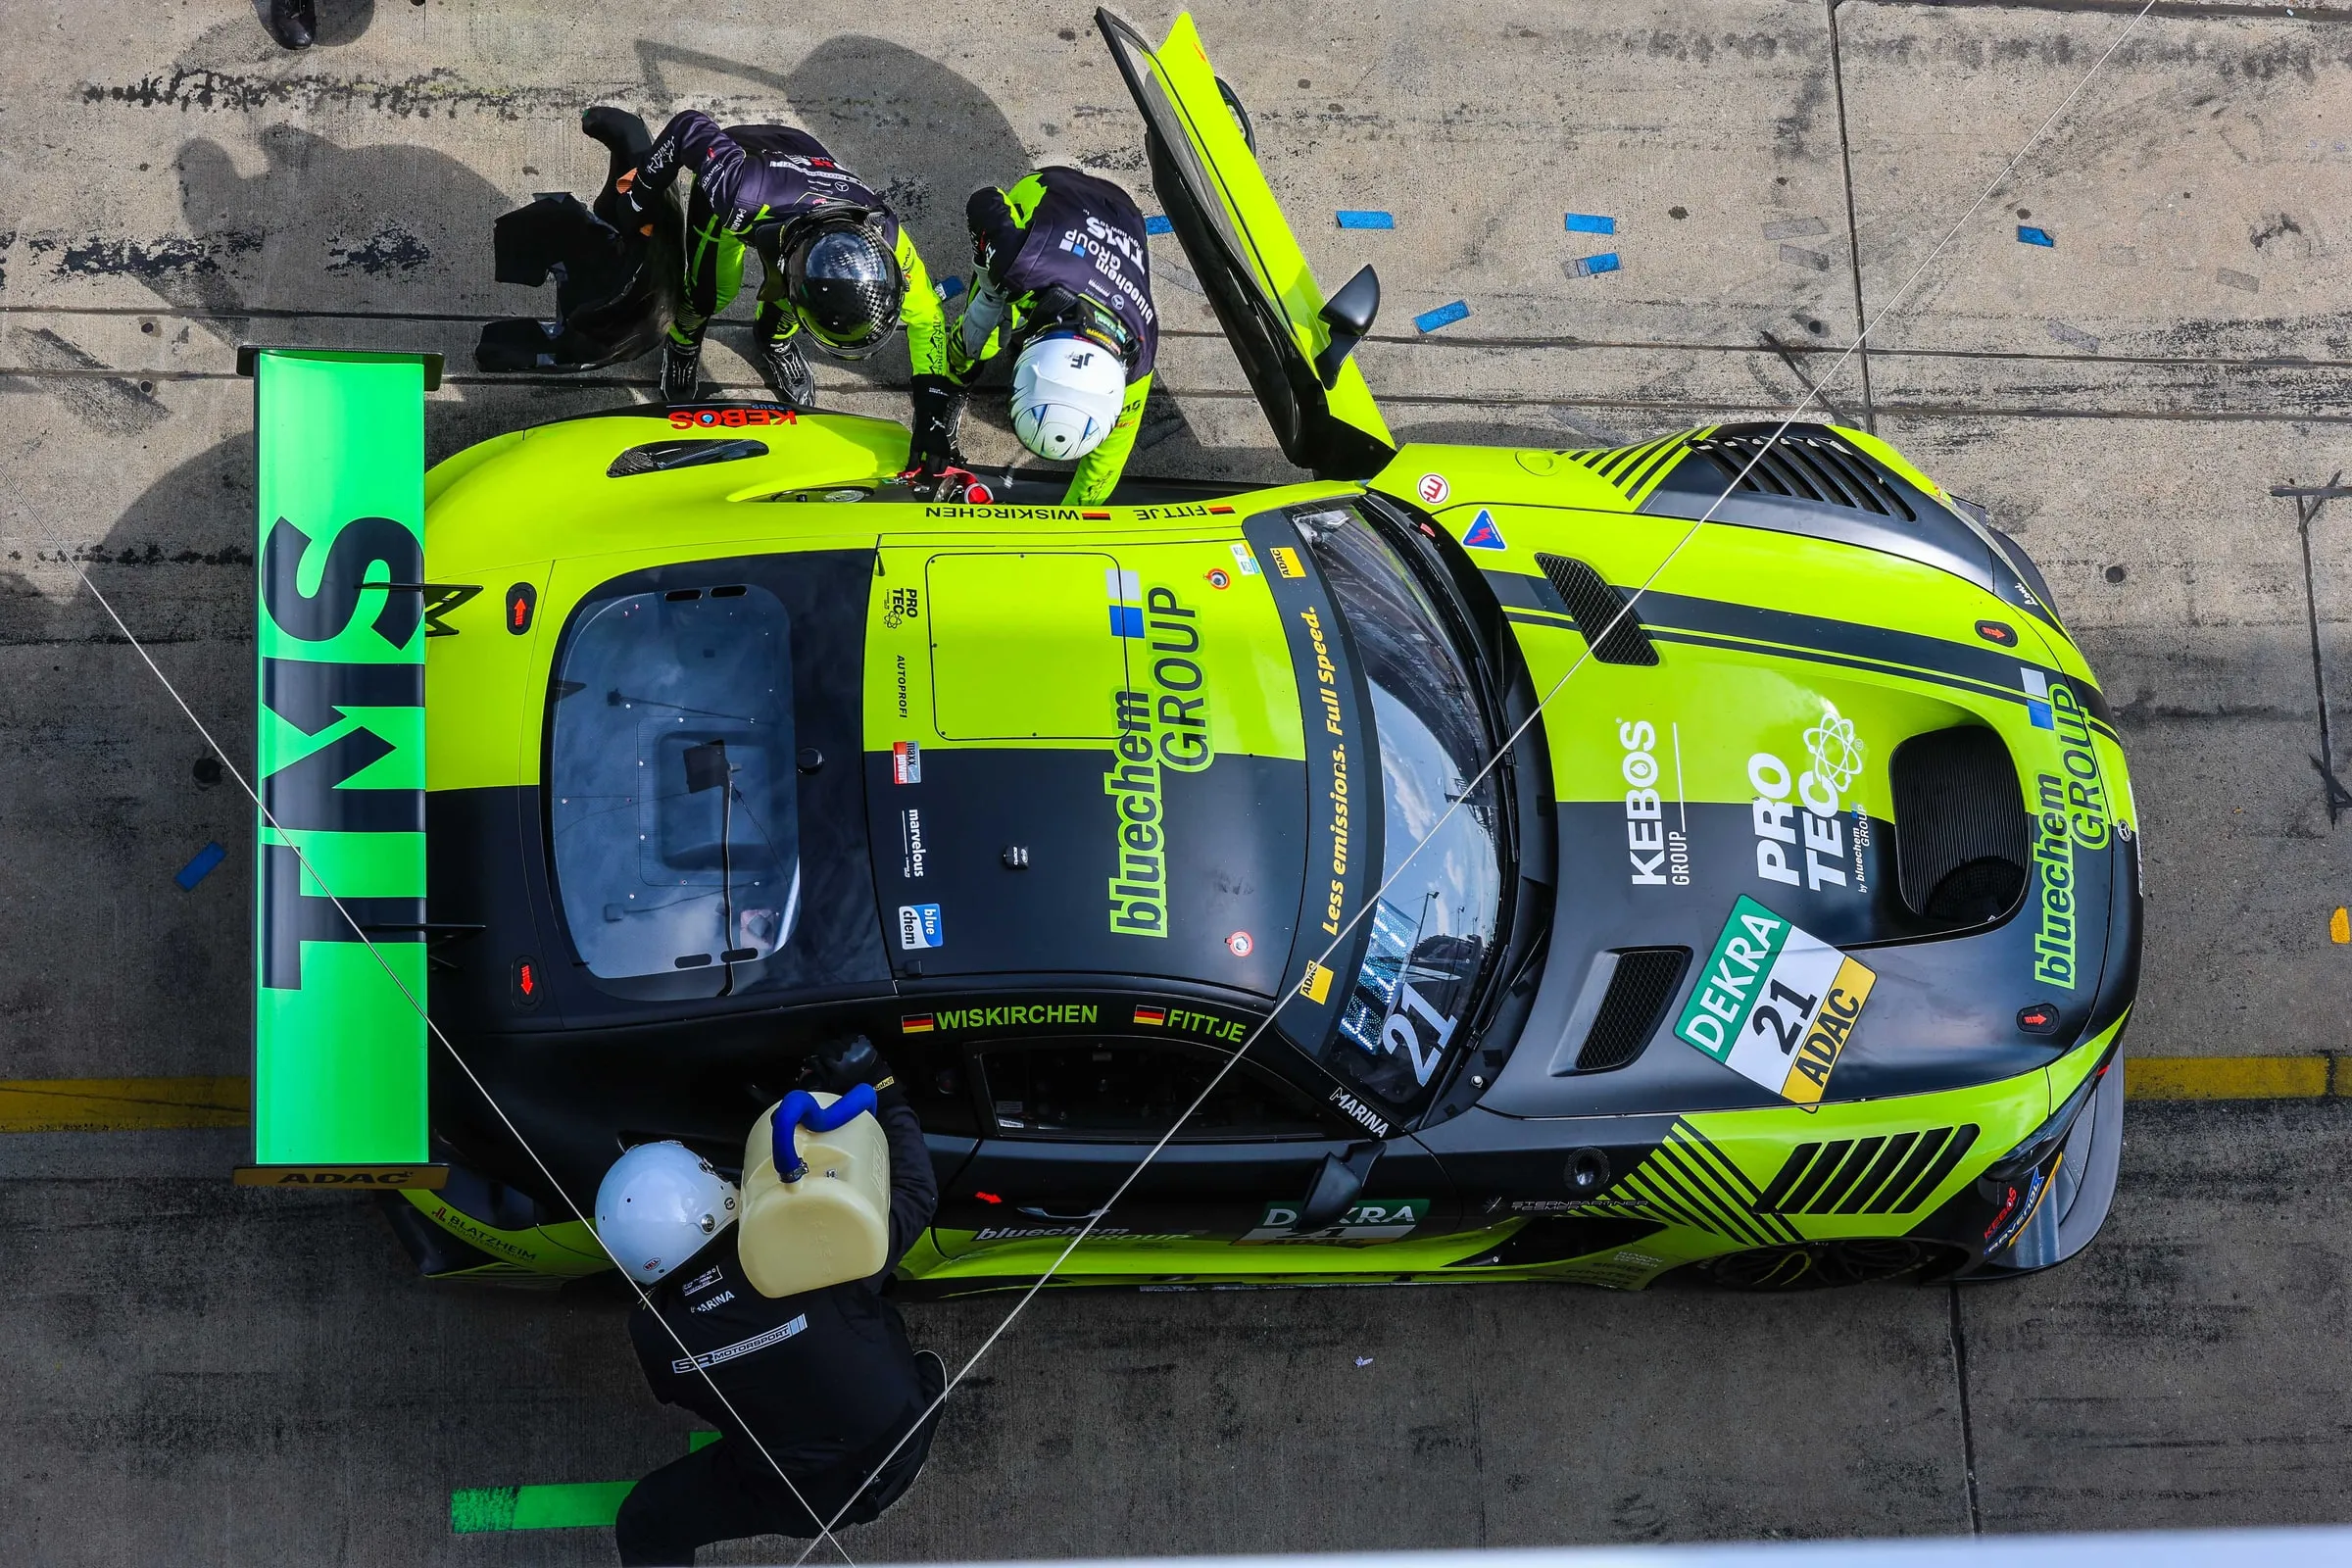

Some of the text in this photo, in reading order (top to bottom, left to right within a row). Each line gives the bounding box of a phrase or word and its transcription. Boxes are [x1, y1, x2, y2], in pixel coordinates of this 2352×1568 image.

[1064, 228, 1121, 270] GROUP
[1086, 217, 1146, 275] TMS
[1095, 258, 1154, 325] bluechem
[668, 410, 798, 430] KEBOS
[925, 505, 1207, 520] WISKIRCHEN FITTJE
[1273, 548, 1291, 578] ADAC
[893, 587, 905, 615] TEC
[906, 588, 918, 618] PRO
[897, 654, 907, 718] AUTOPROFI
[1148, 586, 1207, 772] GROUP
[261, 515, 426, 992] TMS
[896, 754, 907, 784] power
[907, 742, 916, 766] maxx
[1300, 606, 1350, 937] Less emissions. Full Speed.
[2053, 685, 2104, 845] GROUP
[1112, 690, 1163, 933] bluechem
[1619, 720, 1667, 885] KEBOS
[1747, 753, 1800, 887] PRO
[1857, 803, 1871, 848] GROUP
[908, 808, 927, 878] marvelous
[1797, 770, 1847, 892] TEC
[1668, 831, 1690, 886] GROUP
[1851, 826, 1868, 894] by bluechem
[2036, 772, 2072, 983] bluechem
[903, 909, 918, 945] chem
[923, 907, 938, 936] blue
[1685, 913, 1782, 1054] DEKRA
[937, 1004, 1247, 1043] WISKIRCHEN FITTJE
[1382, 982, 1458, 1088] 21
[1751, 978, 1818, 1056] 21
[1794, 988, 1860, 1089] ADAC
[1329, 1086, 1390, 1139] MARINA
[277, 1173, 410, 1184] ADAC
[450, 1215, 537, 1260] BLATZHEIM
[976, 1226, 1130, 1241] bluechem
[1263, 1205, 1416, 1227] DRA
[1984, 1186, 2017, 1240] KEBOS
[644, 1259, 660, 1271] BELL
[714, 1327, 790, 1360] MOTORSPORT
